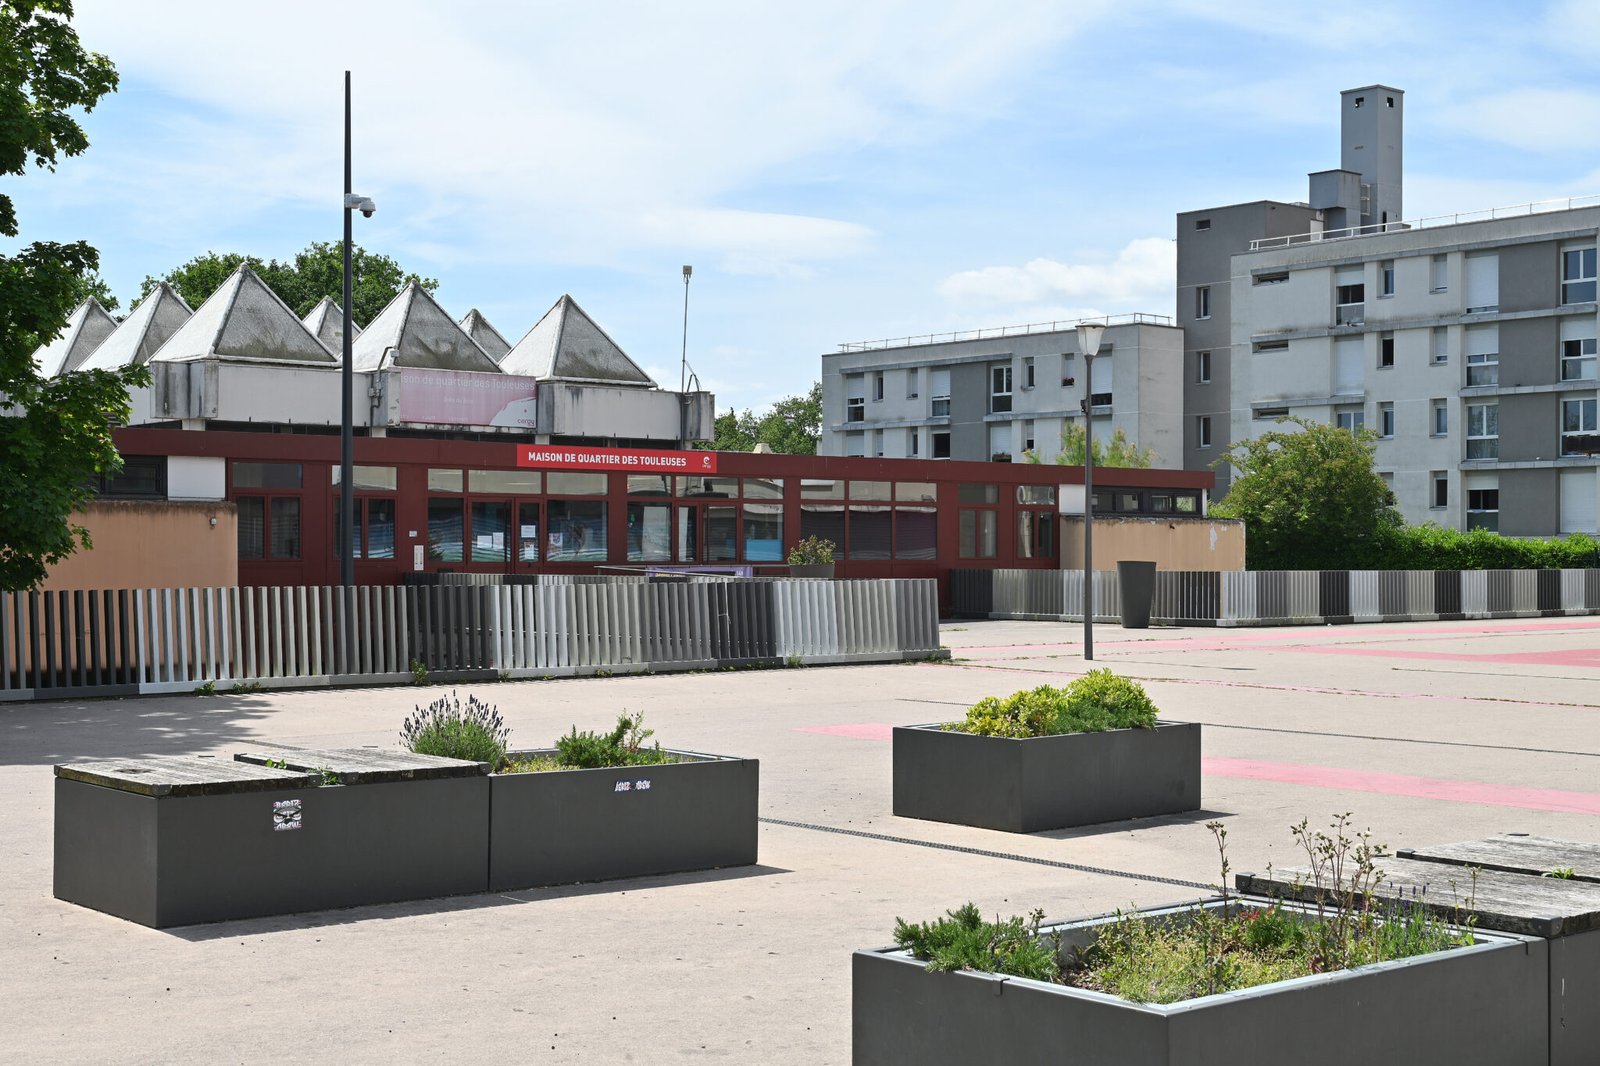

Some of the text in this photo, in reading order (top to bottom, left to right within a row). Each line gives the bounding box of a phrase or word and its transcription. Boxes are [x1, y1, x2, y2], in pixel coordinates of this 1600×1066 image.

[400, 374, 421, 385] ison
[422, 375, 434, 385] de
[436, 376, 472, 388] quartier
[528, 451, 687, 467] MAISON DE QUARTIER DES TOULEUSES
